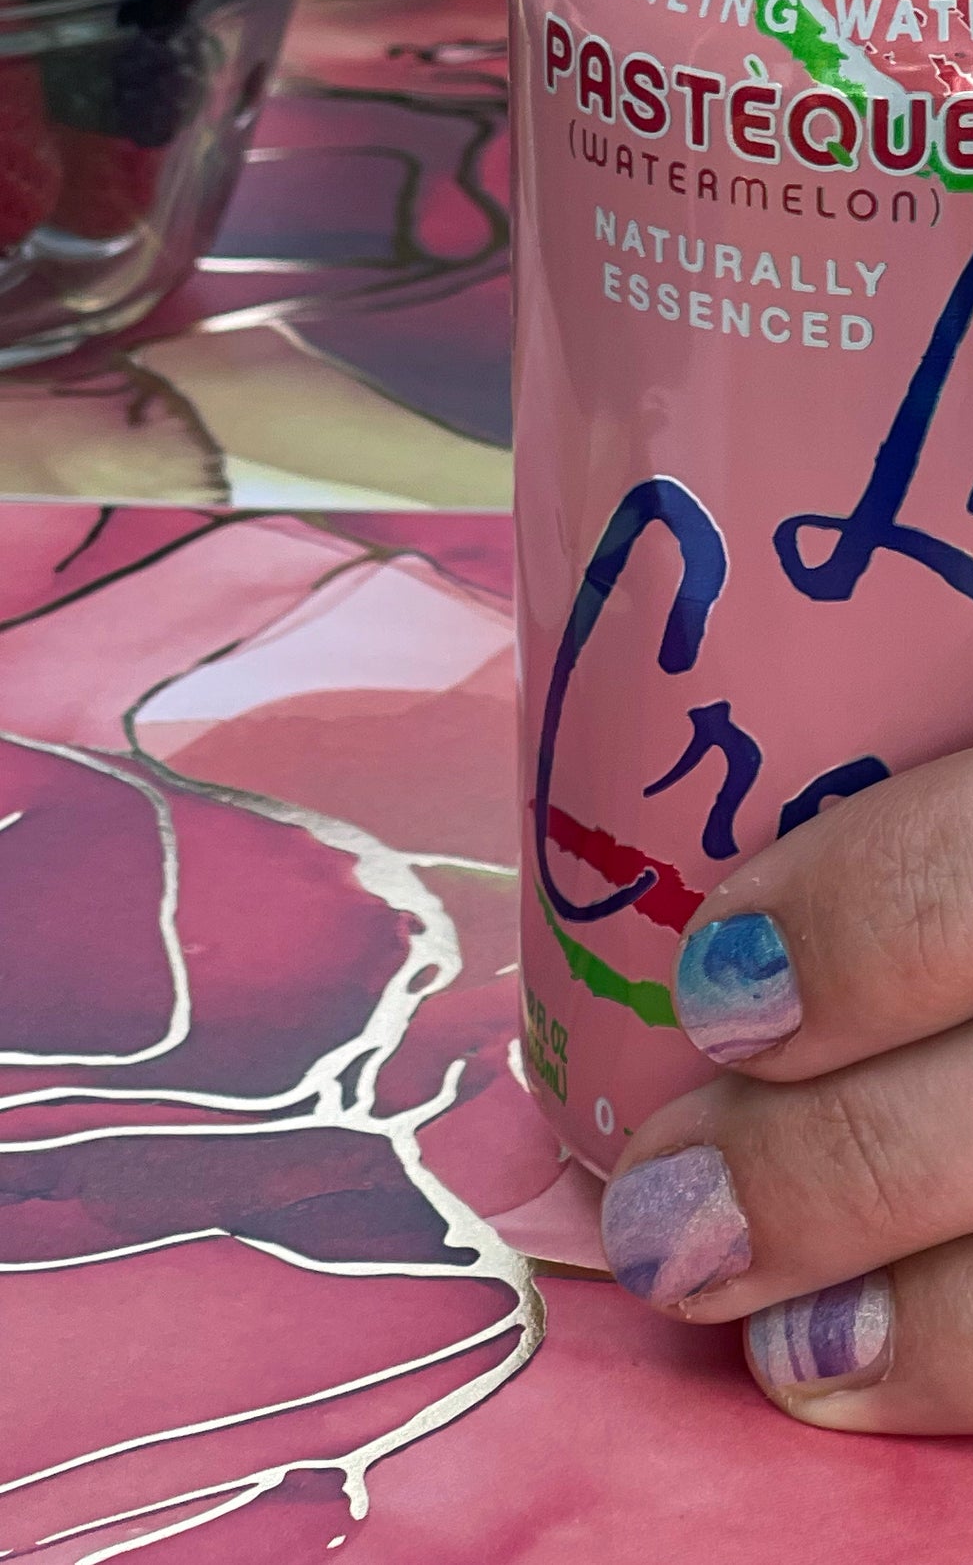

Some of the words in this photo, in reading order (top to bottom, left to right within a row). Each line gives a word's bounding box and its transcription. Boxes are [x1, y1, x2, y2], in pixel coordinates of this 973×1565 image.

[568, 119, 941, 227] (WATERMELON)
[595, 206, 888, 297] NATURALLY
[602, 262, 875, 351] ESSENCED
